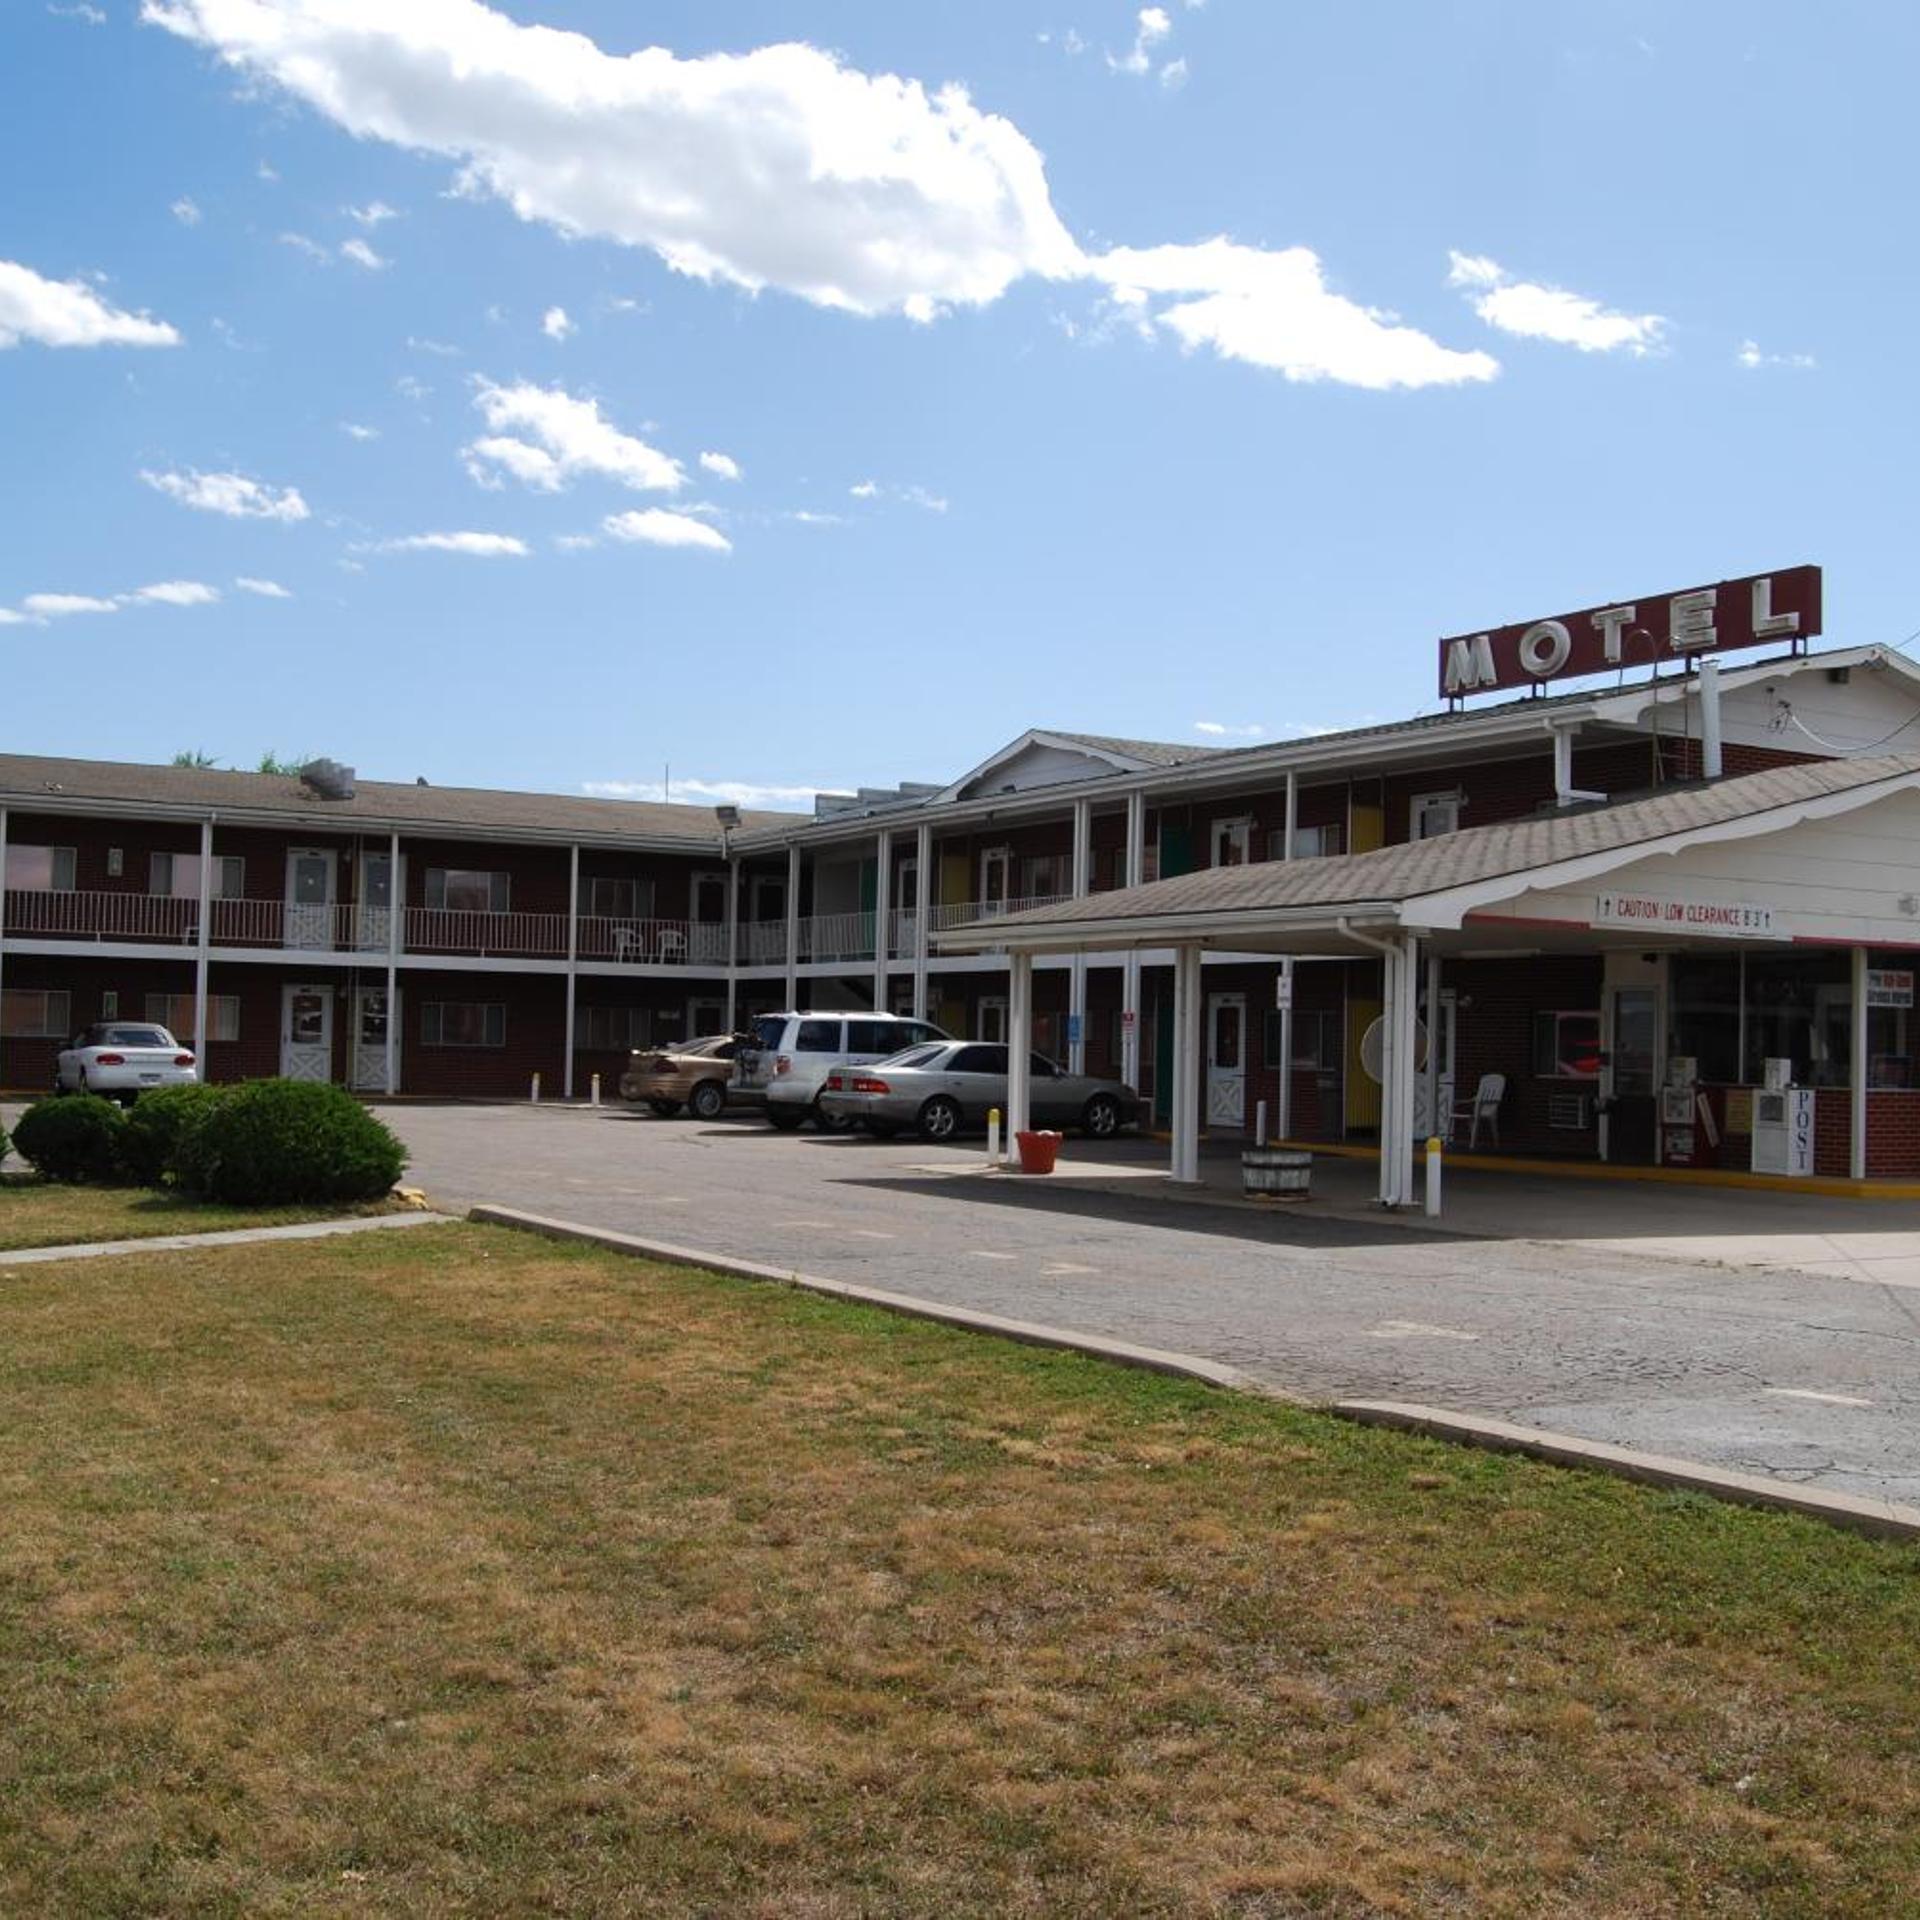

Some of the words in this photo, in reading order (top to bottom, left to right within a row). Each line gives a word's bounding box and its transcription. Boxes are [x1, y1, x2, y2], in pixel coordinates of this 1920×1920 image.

[1446, 578, 1799, 691] MOTEL
[1618, 899, 1659, 919] CAUTION
[1664, 903, 1684, 921] LOW
[1687, 905, 1741, 926] CLEARANCE
[1797, 1091, 1809, 1169] POST
